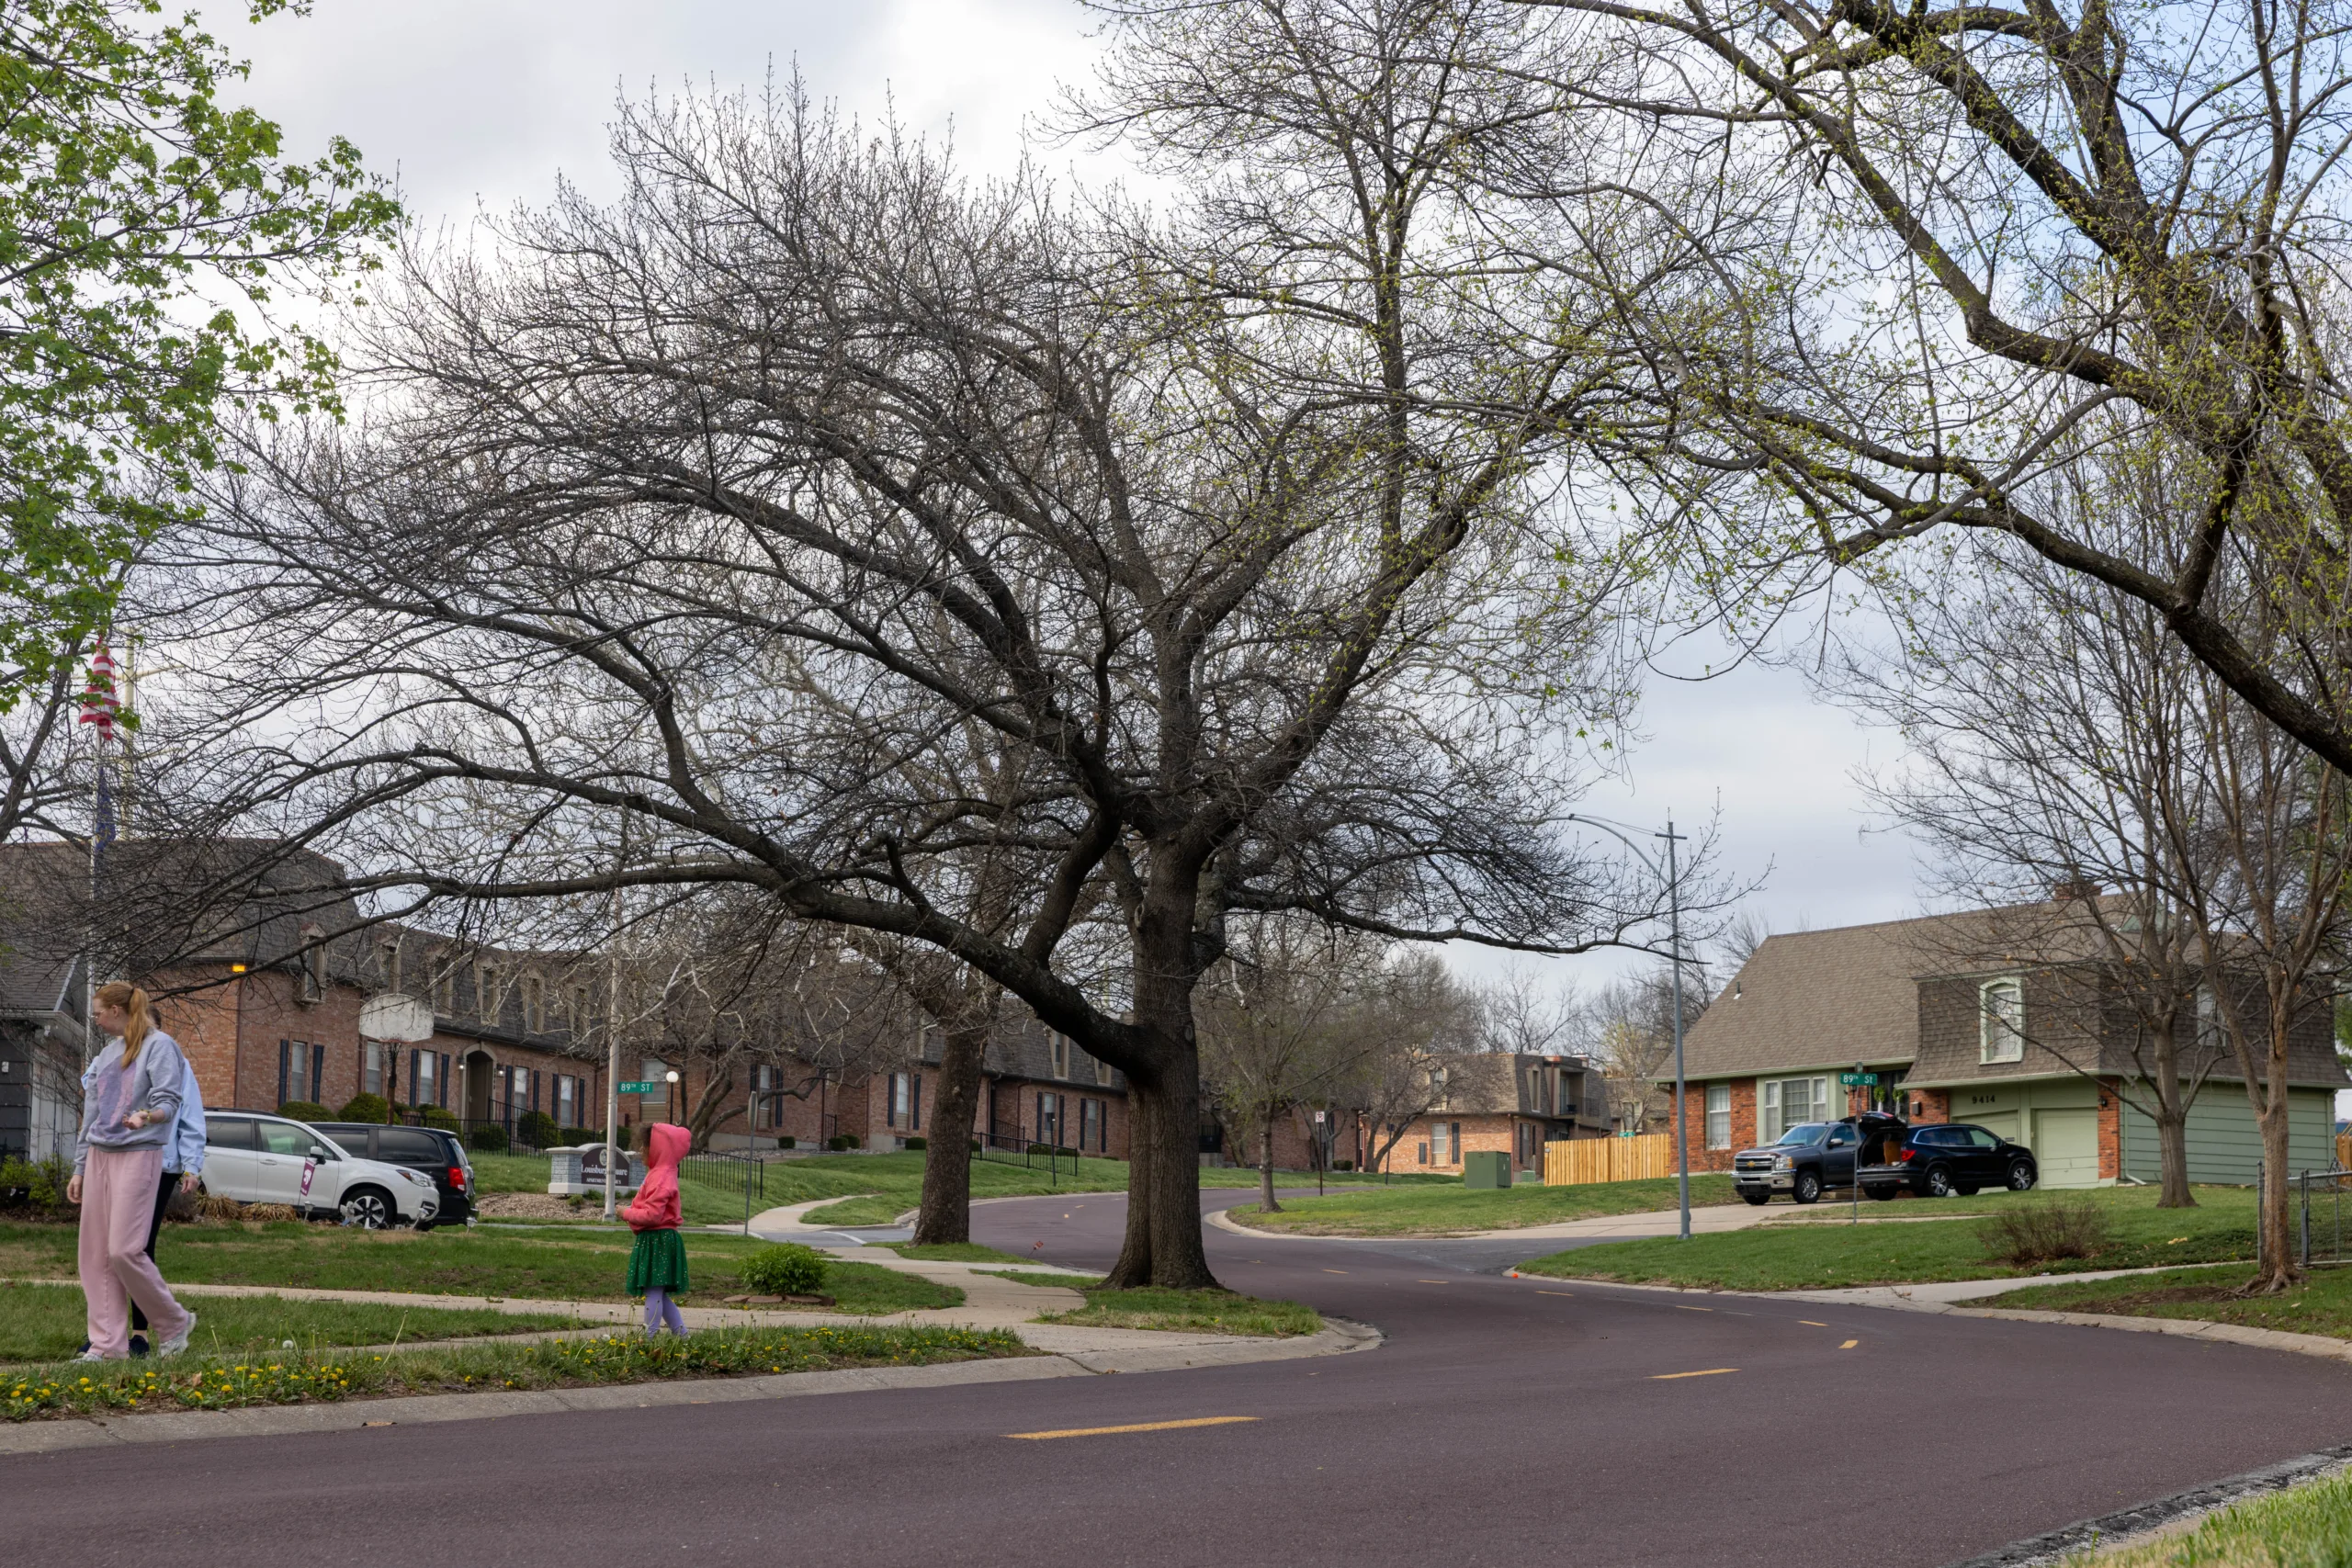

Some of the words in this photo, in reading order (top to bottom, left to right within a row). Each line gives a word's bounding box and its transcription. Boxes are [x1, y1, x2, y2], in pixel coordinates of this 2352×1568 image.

[1864, 1075, 1873, 1084] St
[640, 1083, 650, 1091] ST
[1972, 1095, 1996, 1104] 9414
